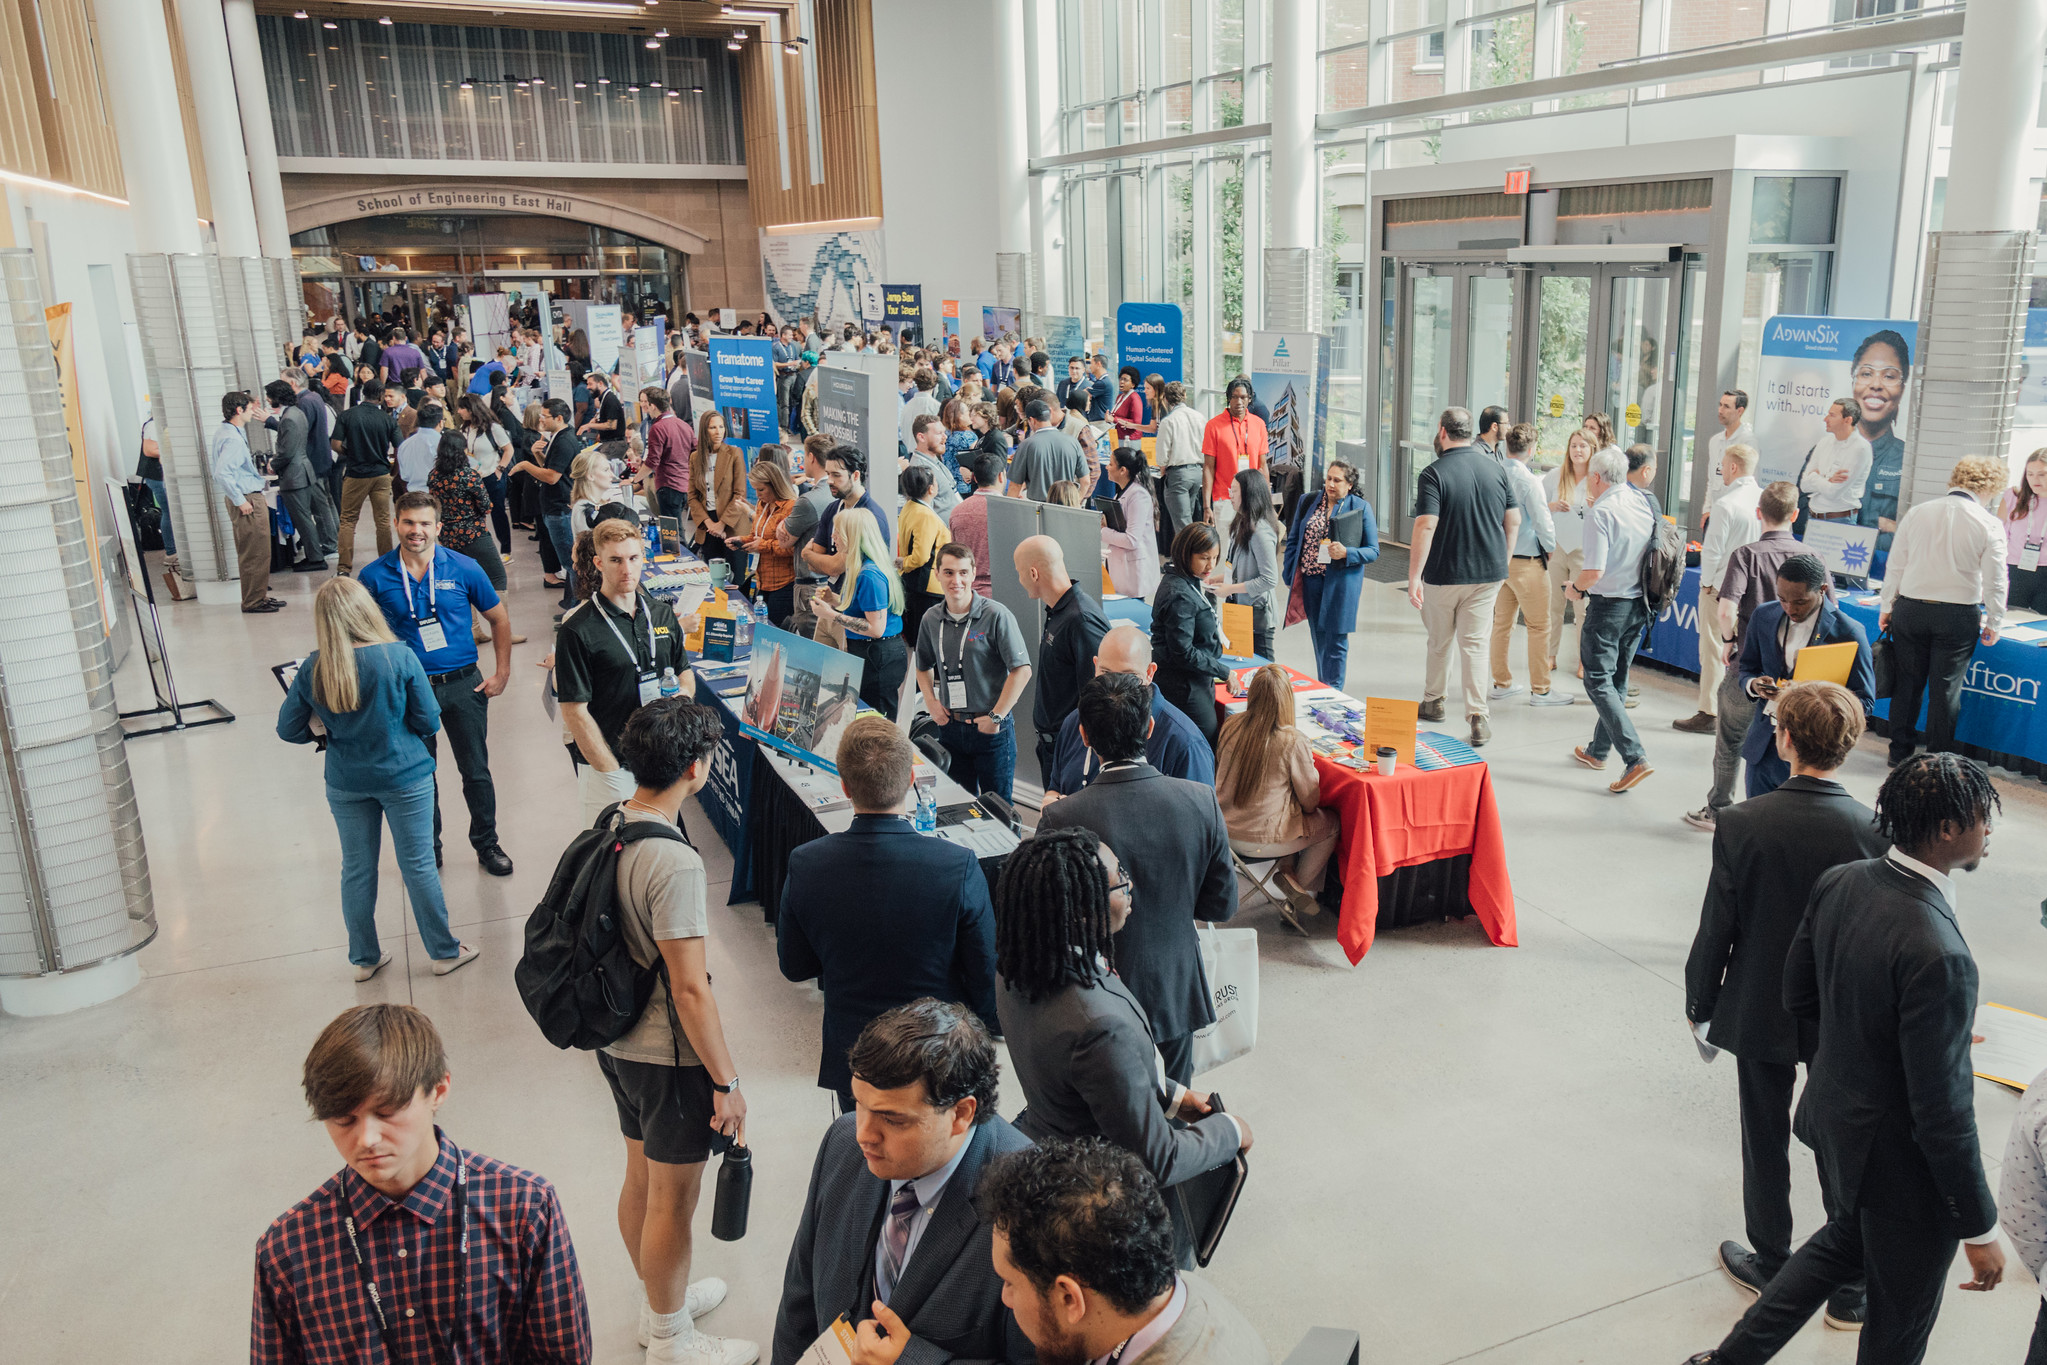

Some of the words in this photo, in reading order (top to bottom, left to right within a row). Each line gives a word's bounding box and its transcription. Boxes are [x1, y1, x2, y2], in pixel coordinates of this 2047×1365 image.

[358, 194, 402, 212] School
[409, 193, 422, 206] of
[428, 192, 506, 207] Engineering
[513, 194, 541, 208] East
[546, 198, 572, 213] Hall
[1124, 322, 1167, 336] CapTech
[716, 351, 764, 367] framatome
[1125, 346, 1174, 355] Human-Centered
[1125, 355, 1145, 363] Digital
[1145, 355, 1172, 363] Solutions
[719, 375, 733, 384] Grow
[733, 376, 746, 385] Your
[746, 376, 765, 386] Career
[1767, 380, 1775, 393] It
[1778, 381, 1793, 395] all
[1795, 384, 1830, 399] starts
[823, 405, 847, 423] MAKING
[846, 411, 860, 427] THE
[823, 422, 858, 444] IMPOSSIBLE
[661, 528, 678, 537] CO-OP
[654, 626, 670, 635] VCU
[1963, 660, 2038, 699] fton
[1214, 984, 1238, 1005] RUST
[840, 1328, 855, 1353] STUD
